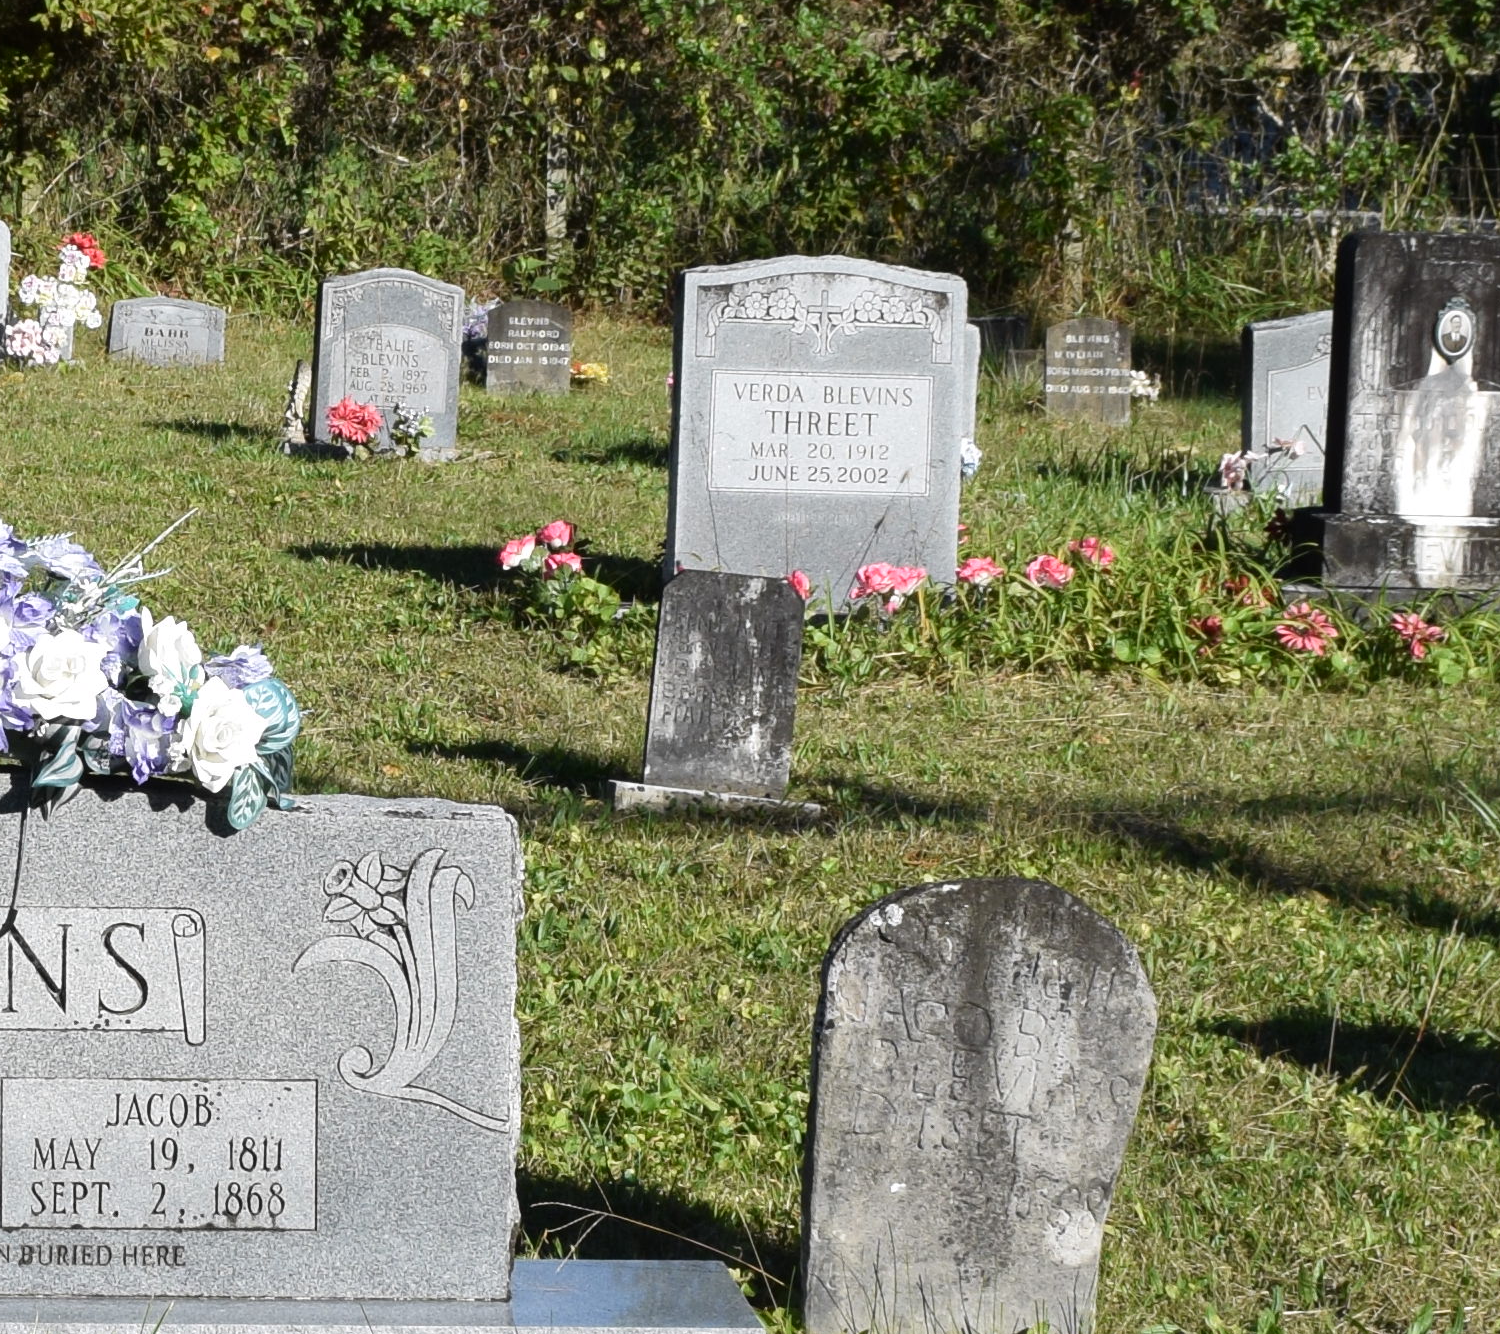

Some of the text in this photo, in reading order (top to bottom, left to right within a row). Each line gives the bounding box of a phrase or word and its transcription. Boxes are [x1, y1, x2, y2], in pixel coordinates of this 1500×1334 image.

[361, 353, 419, 368] BLEVINS
[488, 354, 512, 364] DIED
[513, 355, 533, 364] JAN
[733, 383, 914, 407] VERDA BLEVINS
[765, 410, 879, 436] THREET
[847, 443, 889, 460] 1912
[748, 466, 800, 482] JUNE
[105, 1093, 213, 1129] JACOB
[32, 1137, 284, 1174] MAY 19, 1811
[29, 1181, 286, 1224] SEPT. 2, 1868
[18, 1244, 113, 1267] BURIED
[122, 1245, 187, 1267] HERE
